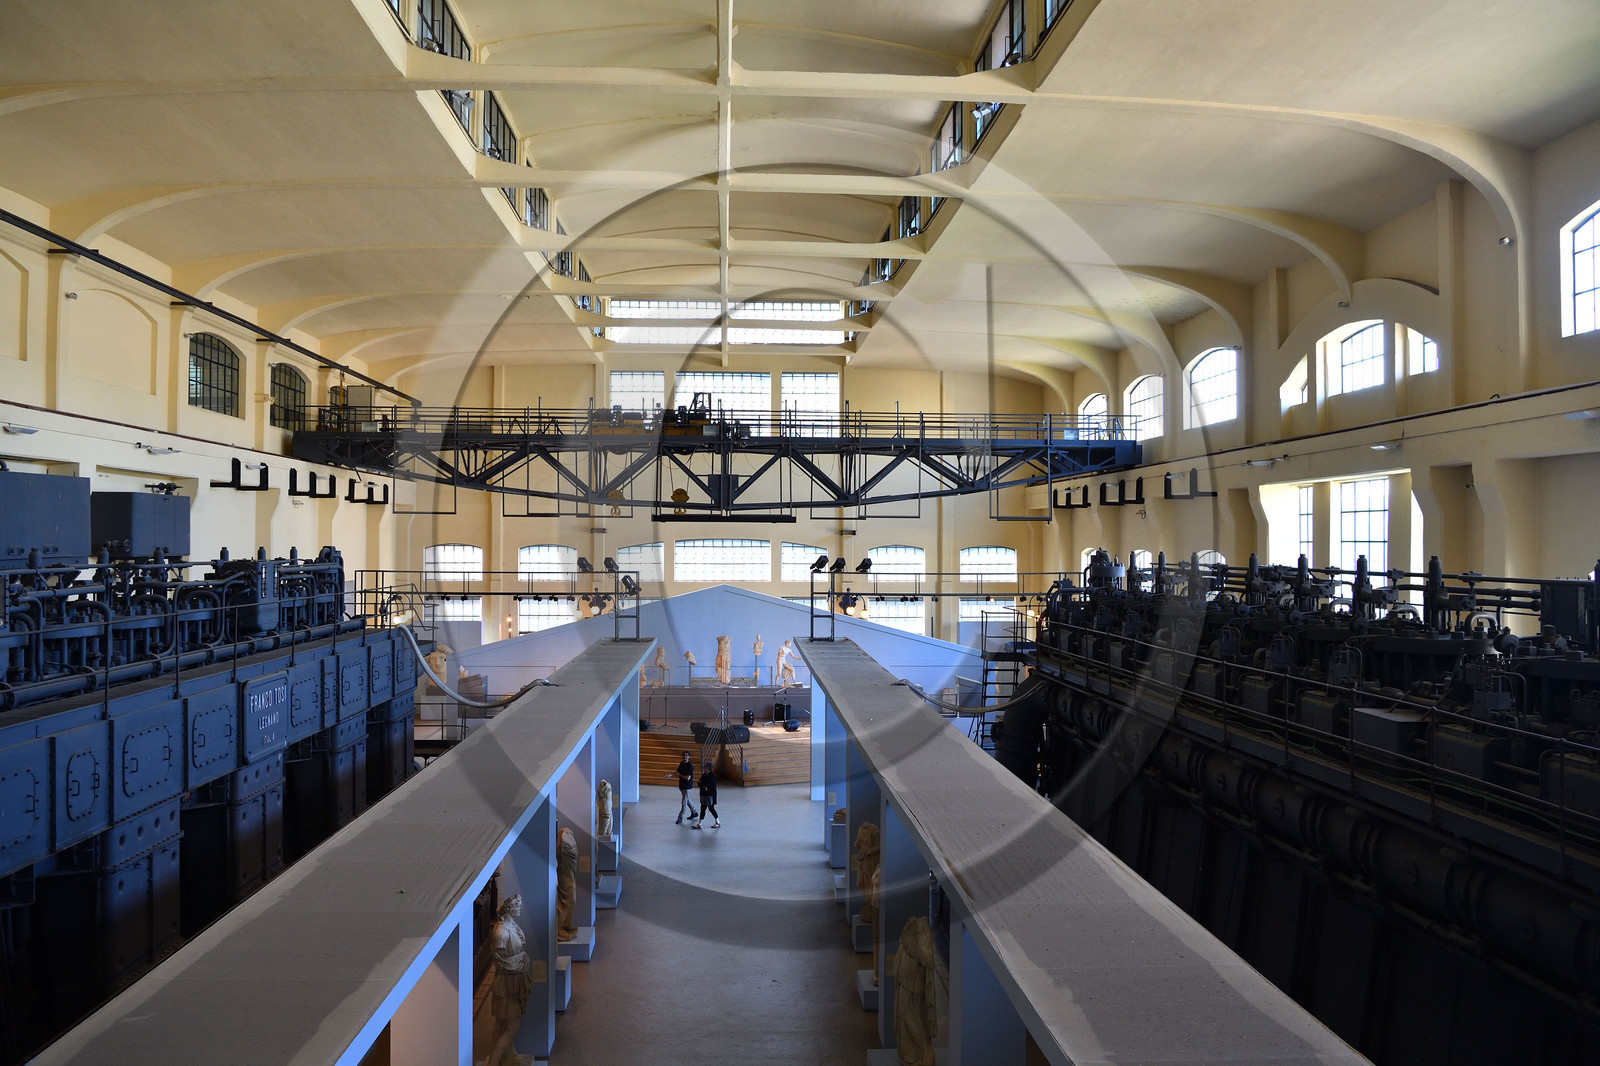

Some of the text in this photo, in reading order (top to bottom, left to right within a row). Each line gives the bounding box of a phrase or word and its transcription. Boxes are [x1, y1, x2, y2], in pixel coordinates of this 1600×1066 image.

[250, 685, 287, 714] FRANCO TOSI
[258, 711, 279, 730] LEGNANO
